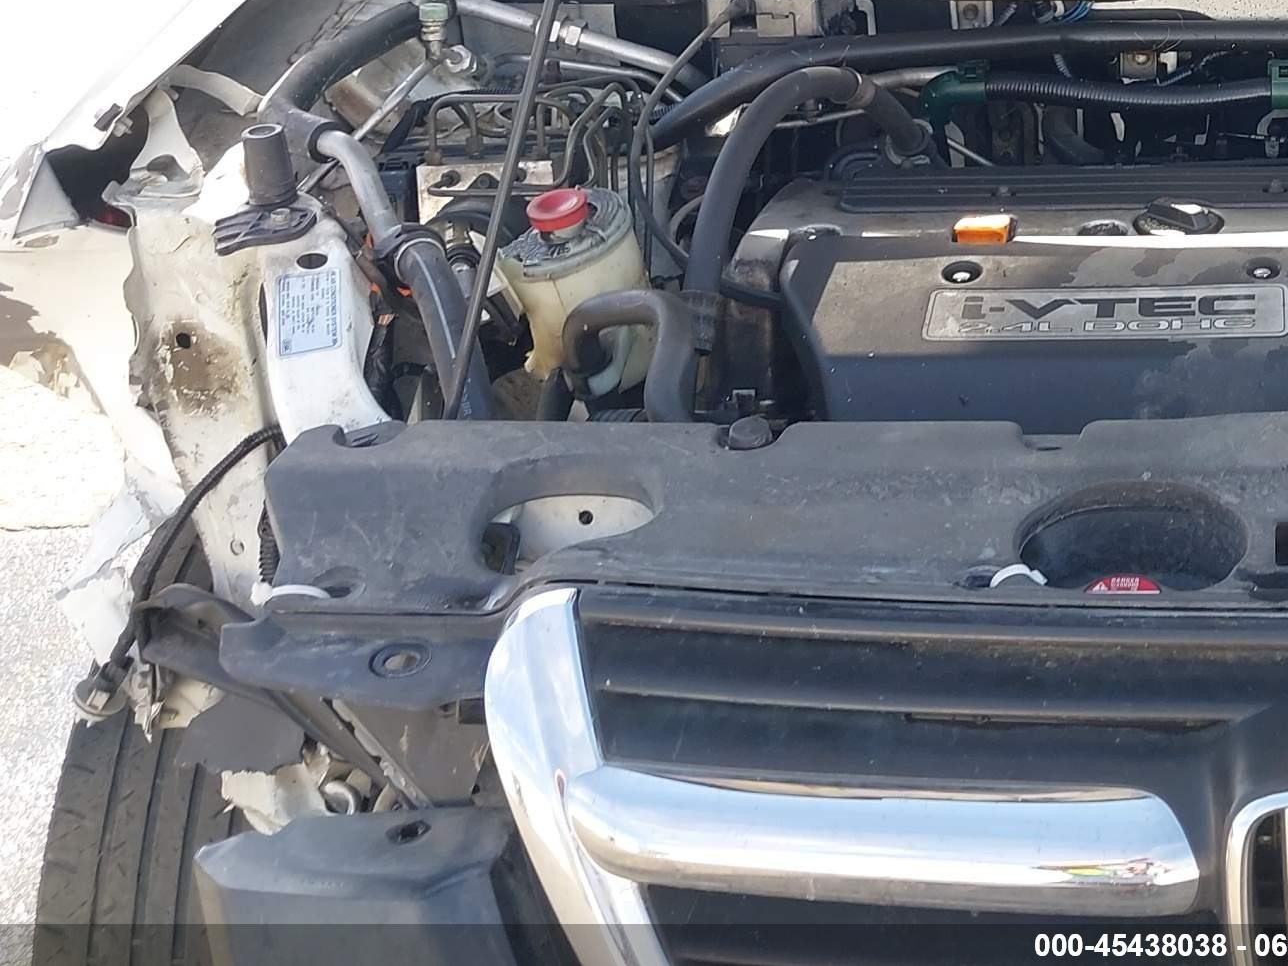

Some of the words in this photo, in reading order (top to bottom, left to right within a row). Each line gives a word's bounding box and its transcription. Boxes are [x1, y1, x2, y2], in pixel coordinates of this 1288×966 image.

[961, 294, 1256, 320] i-VTEC
[957, 320, 1073, 333] 2.4L
[1083, 318, 1256, 332] DOHC
